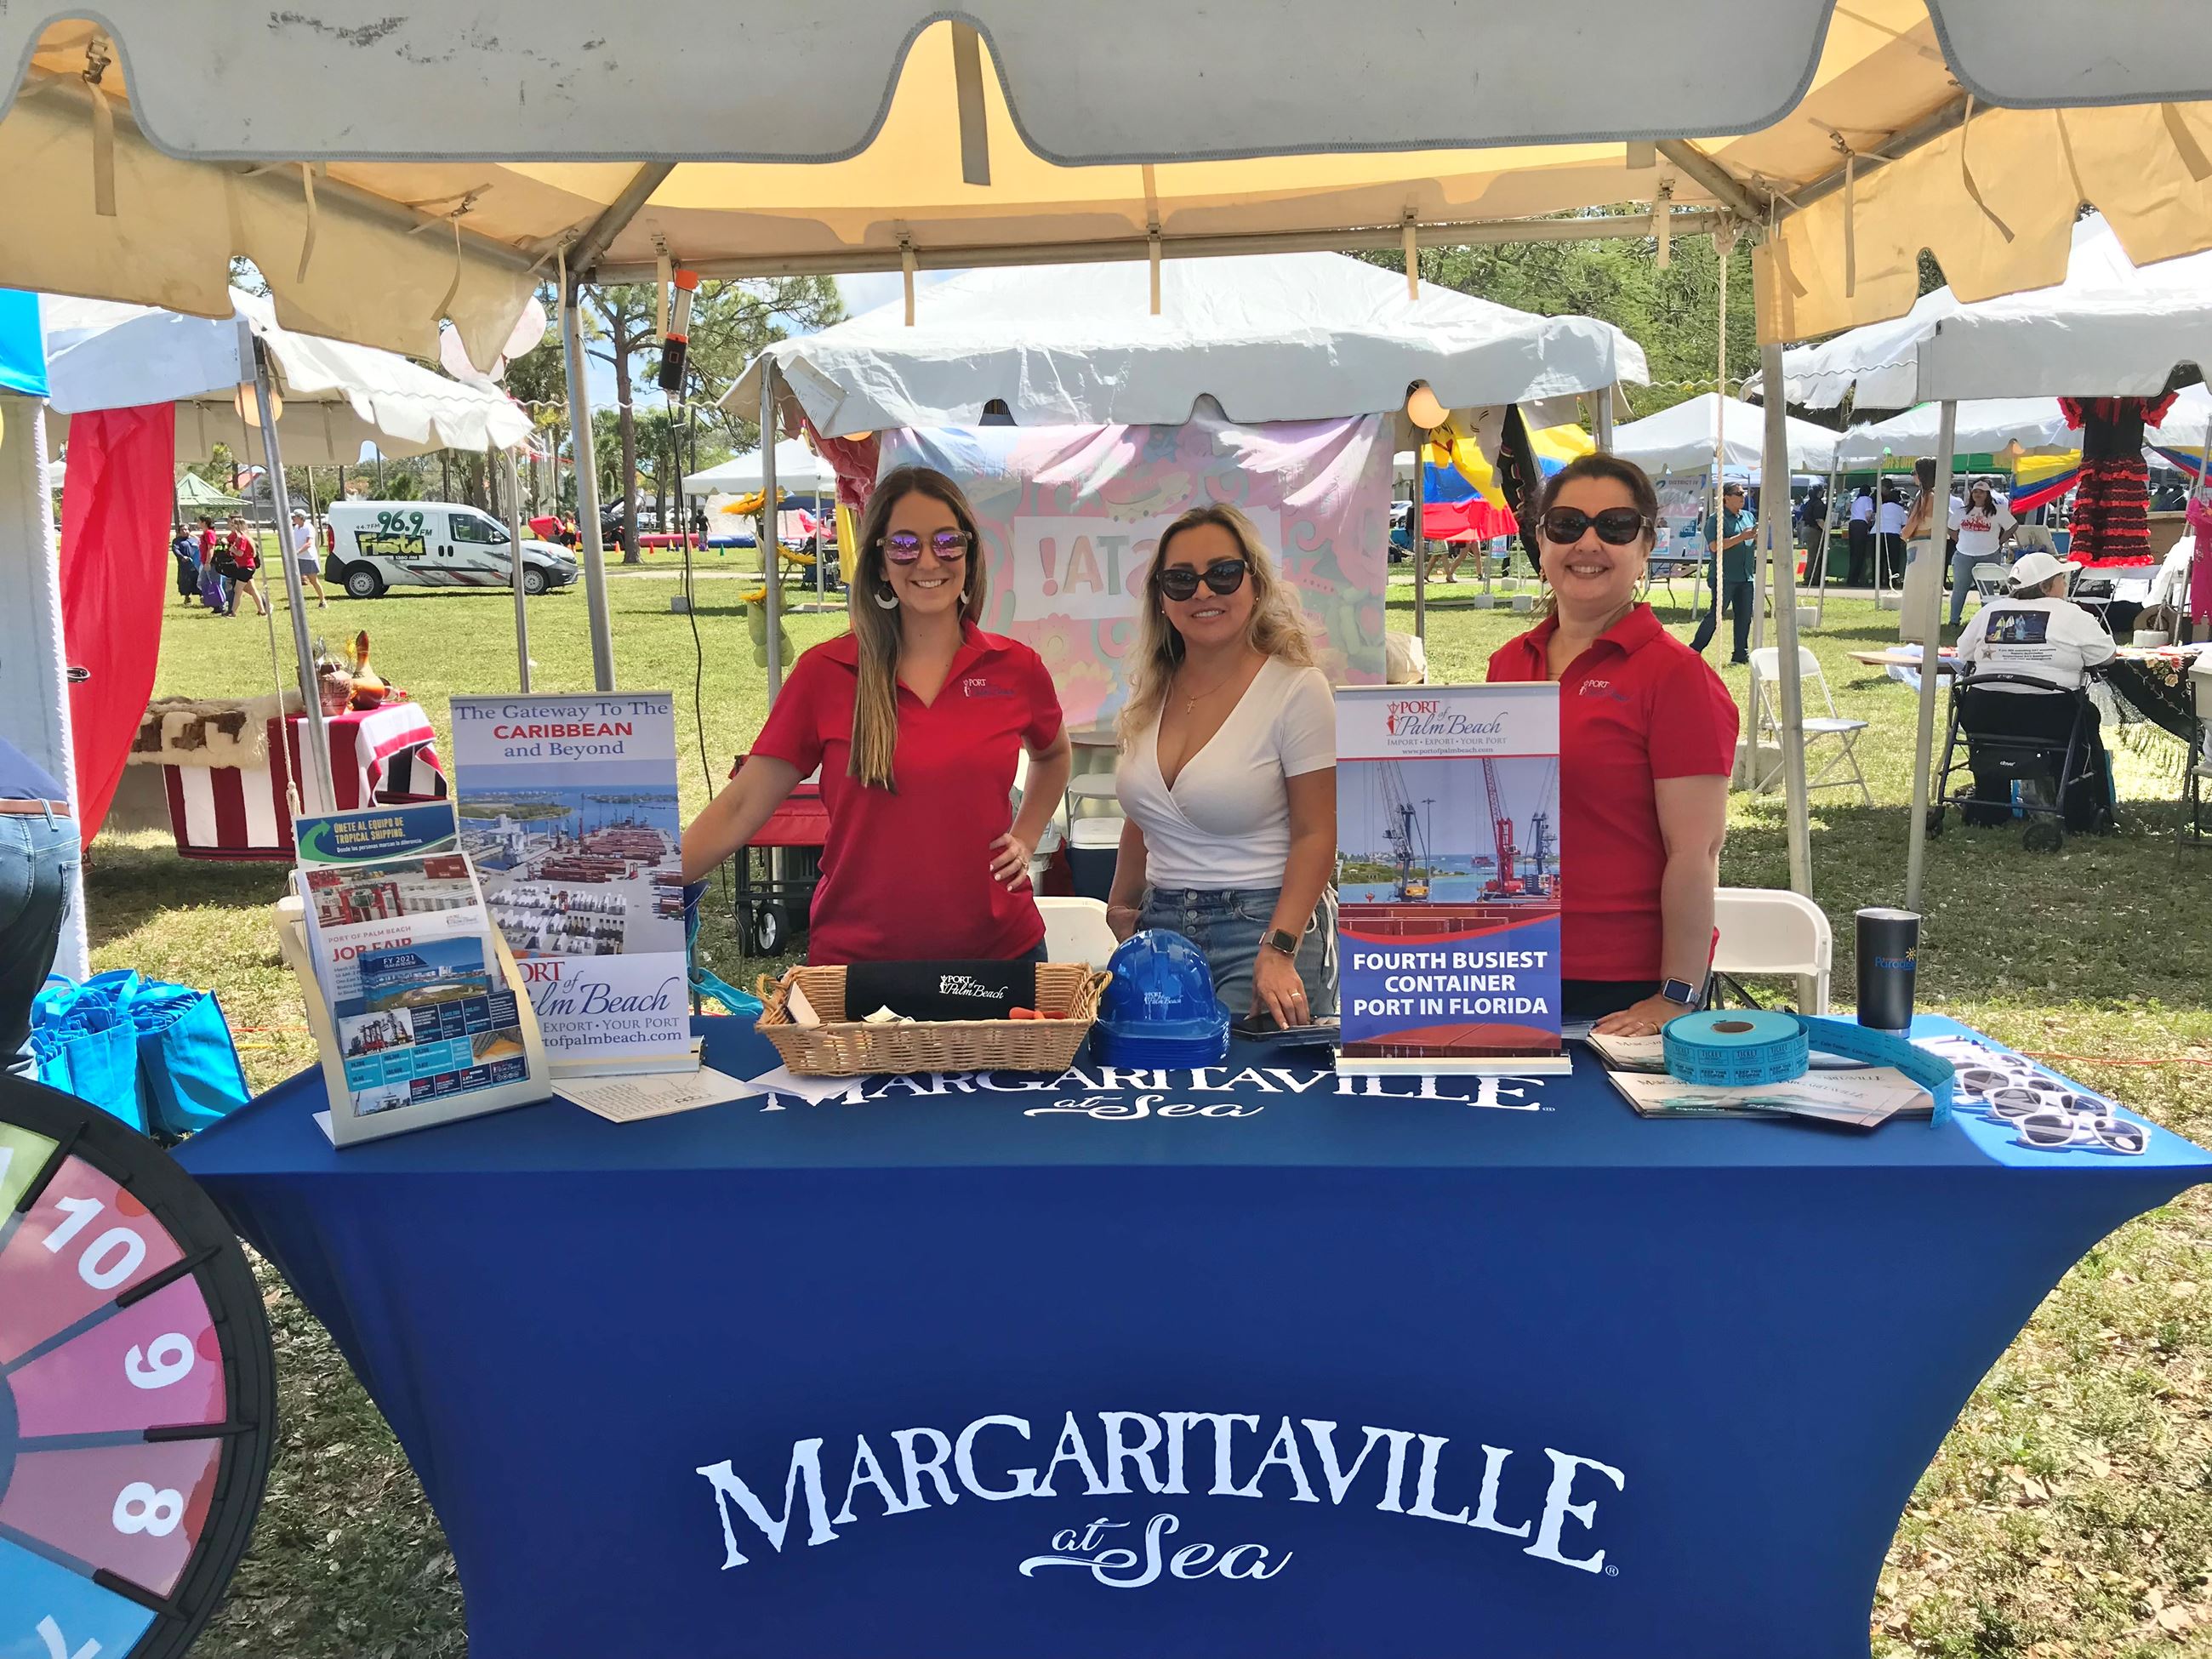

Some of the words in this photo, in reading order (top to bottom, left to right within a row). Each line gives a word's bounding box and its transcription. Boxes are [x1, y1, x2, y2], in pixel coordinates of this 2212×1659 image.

[377, 510, 424, 538] 96.9
[359, 533, 424, 556] Fiesta
[1588, 680, 1610, 688] PORT
[455, 705, 496, 721] The
[503, 704, 590, 721] Gateway
[596, 702, 623, 716] To
[628, 701, 669, 715] The
[1400, 700, 1440, 714] PORT
[1437, 706, 1451, 721] of
[493, 721, 634, 740] CARIBBEAN
[1400, 713, 1445, 737] Palm
[1447, 711, 1508, 735] Beach
[504, 743, 543, 757] and
[549, 741, 624, 761] Beyond
[1402, 747, 1494, 755] www.portofpalmbeach.com
[358, 820, 367, 831] AL
[368, 818, 393, 830] EQUIPO
[394, 817, 404, 827] DE
[334, 831, 370, 845] TROPICAL
[328, 935, 349, 944] PORT
[386, 926, 412, 934] BEACH
[396, 955, 414, 963] 2021
[1353, 952, 1446, 971] FOURTH
[1452, 950, 1548, 969] BUSIEST
[562, 970, 584, 994] of
[947, 975, 972, 983] PORT
[1384, 974, 1516, 993] CONTAINER
[579, 977, 680, 1015] Beach
[945, 983, 973, 995] Palm
[972, 984, 1008, 999] Beach
[1354, 998, 1412, 1017] PORT
[1419, 998, 1444, 1015] IN
[1449, 996, 1548, 1015] FLORIDA
[544, 1021, 593, 1033] EXPORT
[602, 1019, 640, 1030] YOUR
[646, 1017, 680, 1028] PORT
[542, 1030, 682, 1049] tofpalmbeach.com
[1023, 1093, 1264, 1120] Sea
[1052, 1094, 1121, 1109] at
[42, 1195, 146, 1291] 10
[124, 1331, 195, 1388] 9
[696, 1411, 1626, 1574] MARGARITAVILLE
[112, 1481, 183, 1537] 8
[1052, 1517, 1131, 1551] at
[1019, 1514, 1293, 1588] Sea
